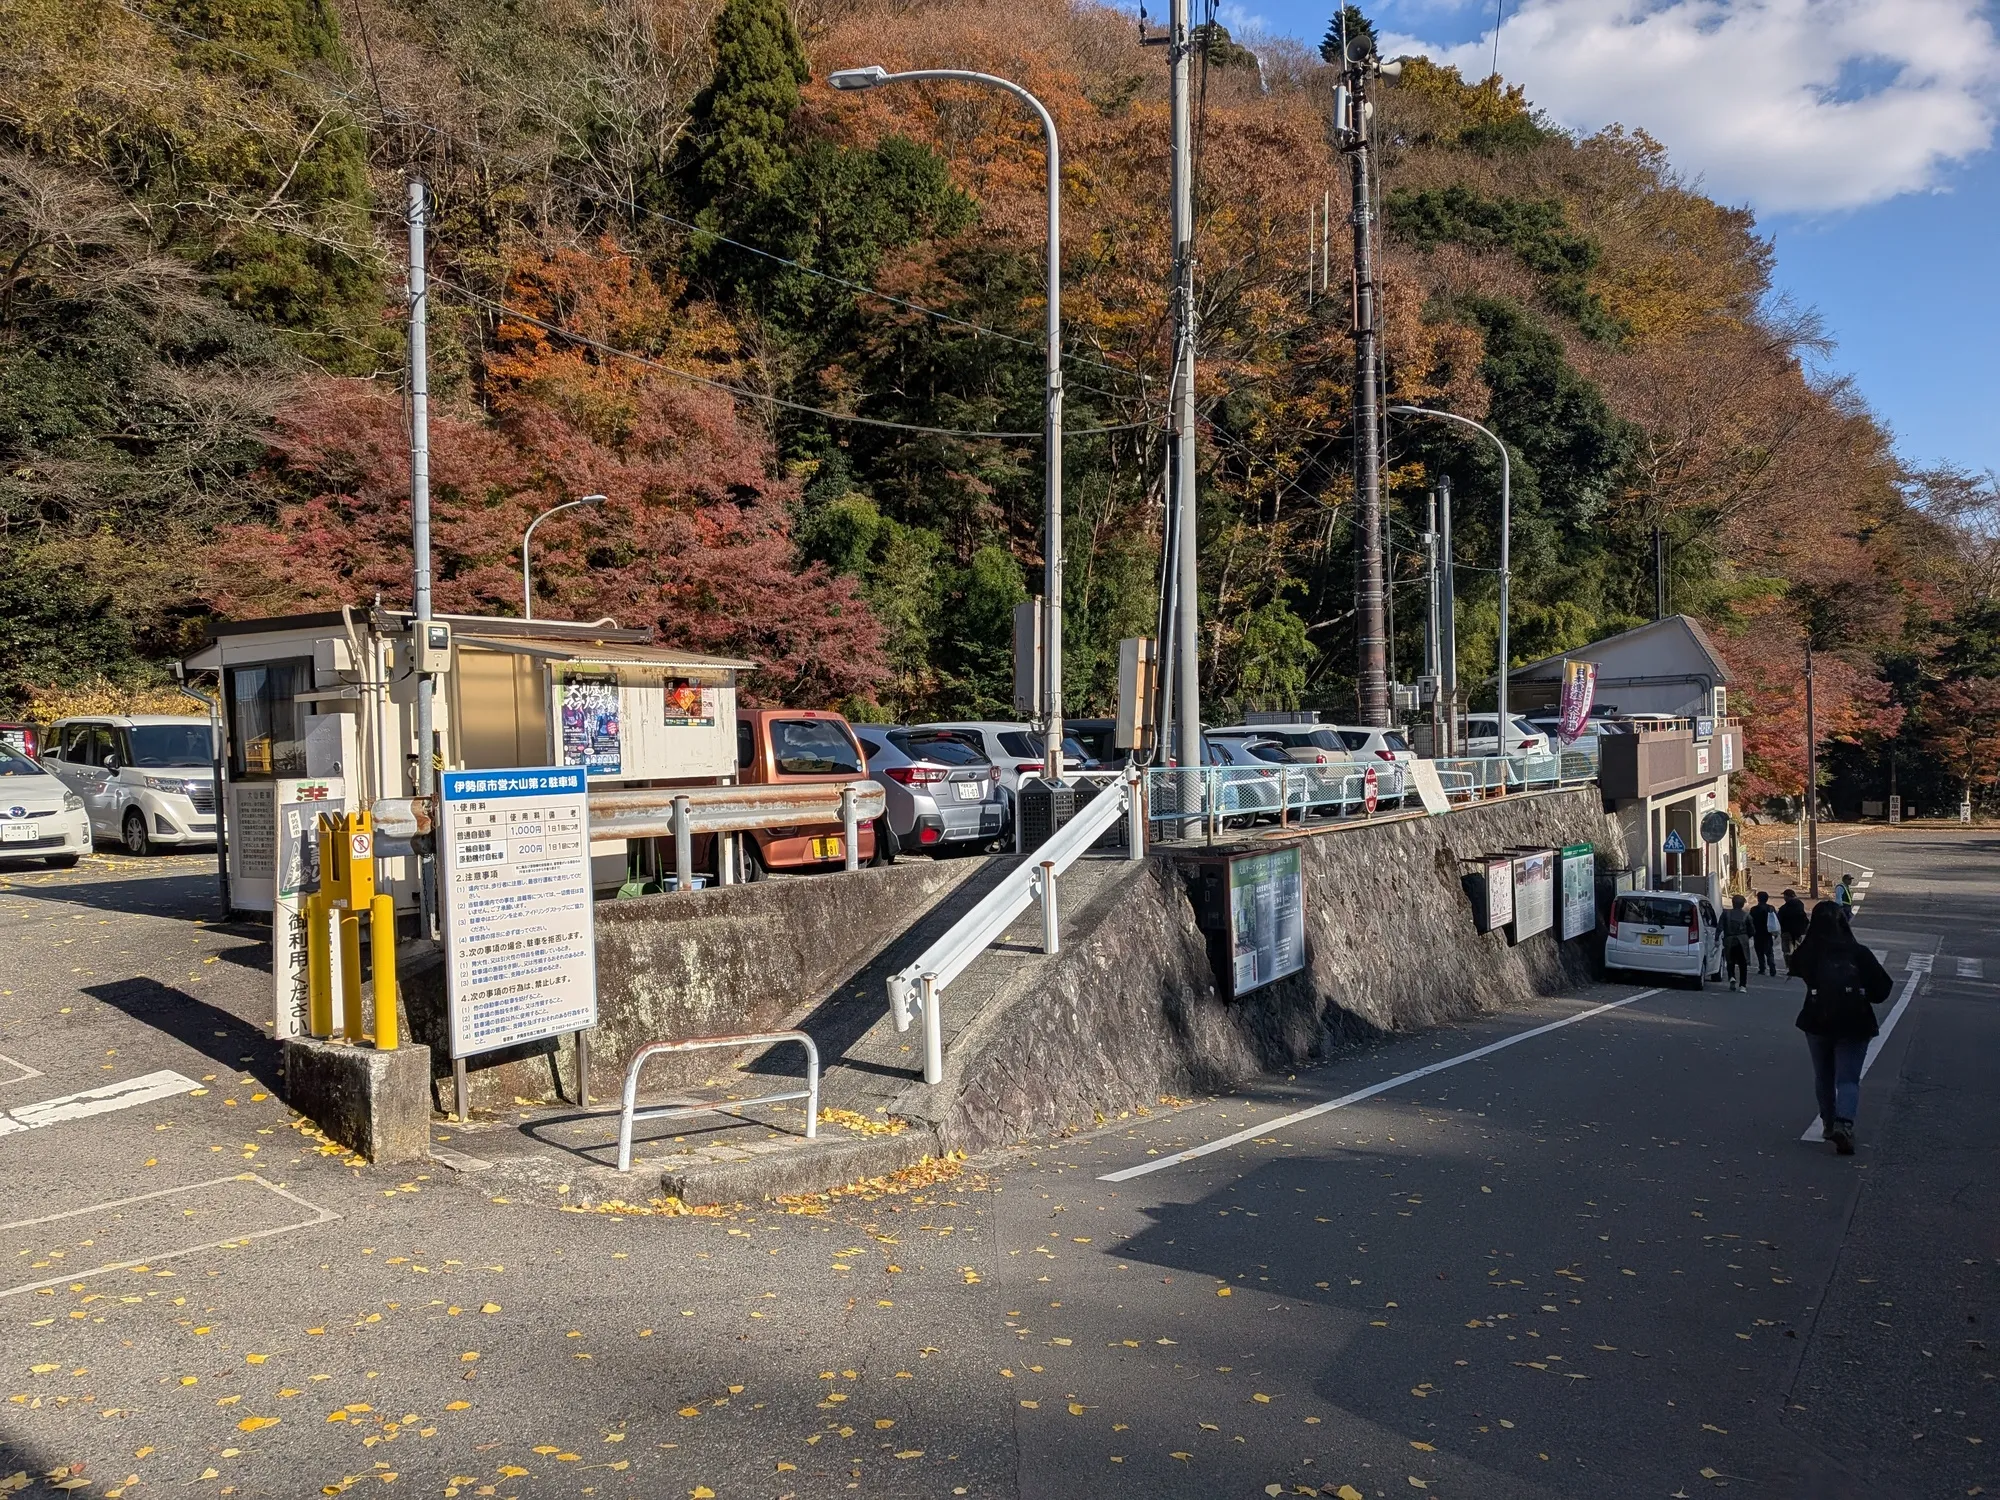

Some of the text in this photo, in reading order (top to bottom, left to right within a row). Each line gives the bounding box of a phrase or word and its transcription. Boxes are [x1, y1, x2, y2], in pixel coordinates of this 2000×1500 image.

[453, 775, 577, 793] 伊勢原市営大山第2駐車場
[456, 829, 491, 840] 普通自動車
[511, 824, 541, 835] 1,000円
[458, 843, 490, 853] 二輪自動車
[518, 844, 542, 854] 200円
[459, 851, 503, 863] 原動機付自転車
[456, 869, 498, 882] 2.注意事項
[288, 914, 308, 1034] 御利用ください
